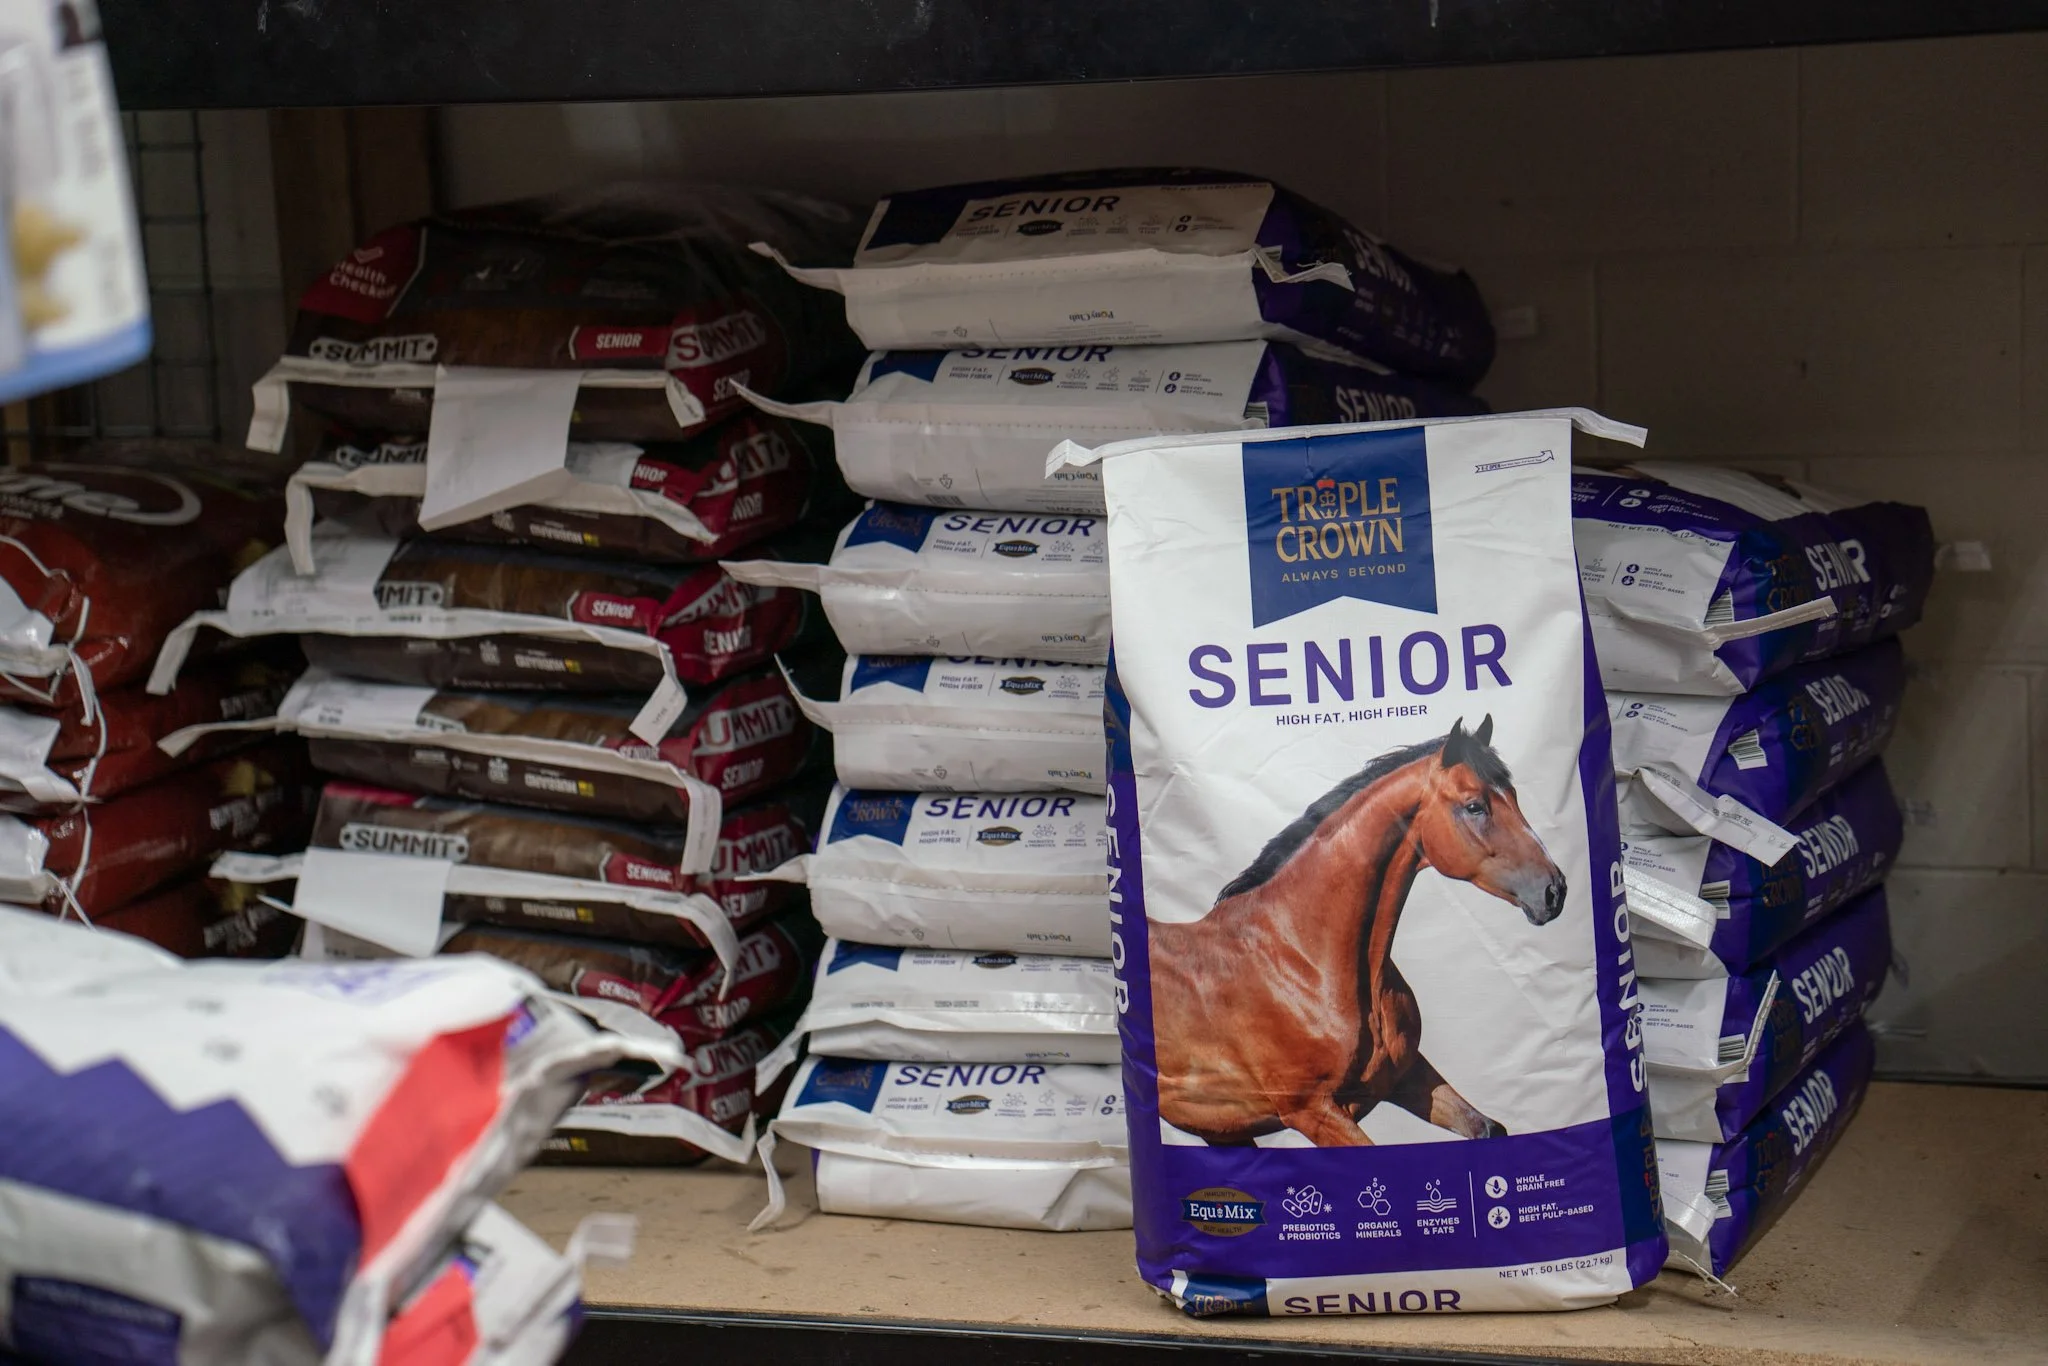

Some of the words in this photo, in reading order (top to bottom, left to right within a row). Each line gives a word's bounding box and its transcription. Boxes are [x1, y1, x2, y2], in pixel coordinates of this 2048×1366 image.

[967, 194, 1120, 223] SENIOR
[326, 340, 419, 360] SUMMIT
[595, 332, 643, 349] SENIOR
[634, 463, 669, 482] NIOR
[1271, 477, 1401, 524] TRIPLE
[943, 514, 1097, 538] SENIOR
[1275, 517, 1404, 564] CROWN
[1281, 568, 1339, 583] ALWAYS
[1349, 563, 1407, 578] BEYOND
[591, 600, 637, 620] SENIOR
[1187, 623, 1513, 709] SENIOR
[938, 681, 960, 689] HIGH
[960, 682, 984, 690] FIBER
[940, 674, 961, 683] HIGH
[703, 702, 783, 746] UMMIT
[1275, 714, 1311, 726] HIGH
[1314, 711, 1346, 725] FAT,
[1348, 708, 1383, 722] HIGH
[1386, 704, 1429, 718] FIBER
[924, 795, 1077, 820] SENIOR
[354, 829, 457, 857] SUMMIT
[711, 831, 785, 874] UMMIT
[625, 861, 675, 886] SENIOR
[1642, 861, 1677, 873] PULP-BASED
[894, 1063, 1046, 1088] SENIOR
[1515, 1173, 1545, 1185] WHOLE
[1516, 1182, 1543, 1193] GRAIN
[1544, 1178, 1566, 1189] FREE
[1518, 1204, 1540, 1215] HIGH
[1518, 1212, 1541, 1223] BEET
[1542, 1204, 1594, 1221] PULP-BASED
[1216, 1225, 1243, 1234] HEALTH
[1282, 1223, 1336, 1232] PREBIOTICS
[1357, 1220, 1399, 1230] ORGANIC
[1416, 1217, 1460, 1227] ENZYMES
[1423, 1227, 1430, 1235] &
[1432, 1225, 1455, 1235] FATS
[1278, 1232, 1286, 1241] &
[1287, 1231, 1341, 1241] PROBIOTICS
[1355, 1228, 1402, 1239] MINERALS
[1499, 1270, 1518, 1279] NET
[1521, 1267, 1538, 1277] WT.
[1540, 1265, 1553, 1274] 50
[1555, 1261, 1574, 1272] LBS
[1575, 1258, 1599, 1270] (22.7
[1599, 1253, 1613, 1266] kg)
[1284, 1289, 1462, 1315] SENIOR
